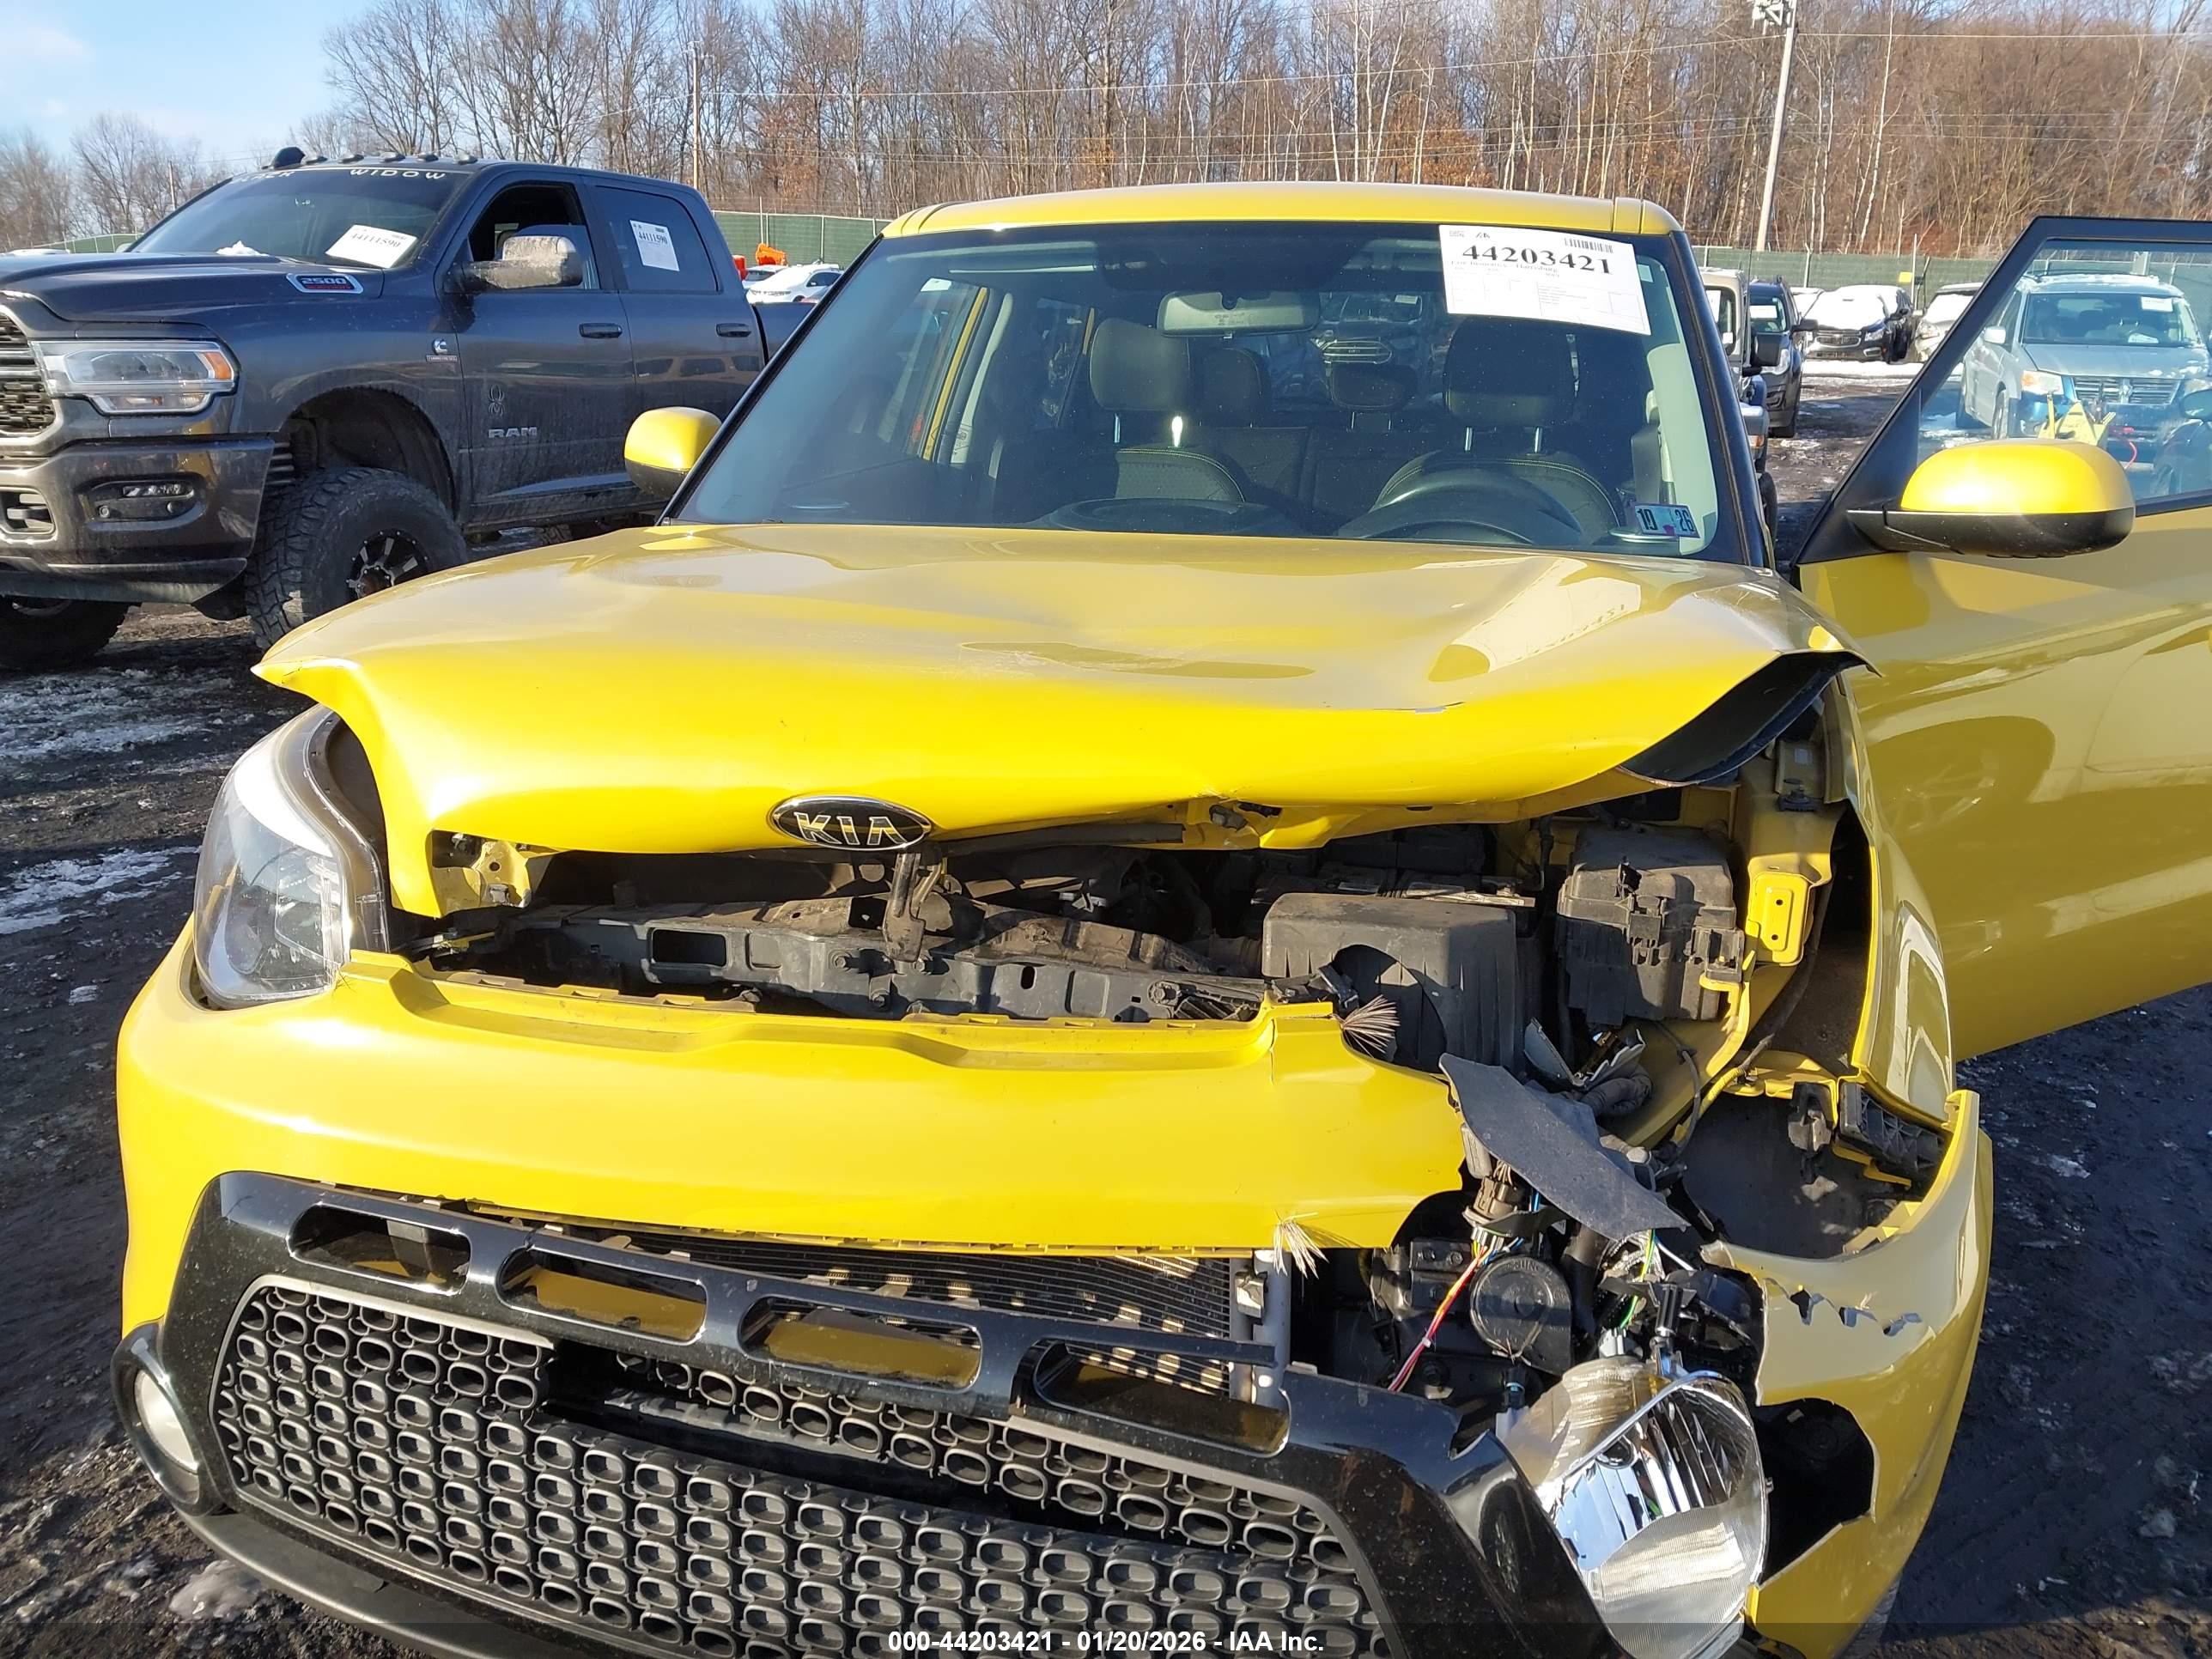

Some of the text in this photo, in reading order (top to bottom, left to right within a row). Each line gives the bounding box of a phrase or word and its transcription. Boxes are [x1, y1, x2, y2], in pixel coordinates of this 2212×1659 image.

[349, 168, 446, 180] WIDOW
[1462, 244, 1613, 275] 44203421
[488, 427, 538, 439] RAM
[1637, 508, 1695, 532] 10 26
[793, 811, 908, 846] KIA
